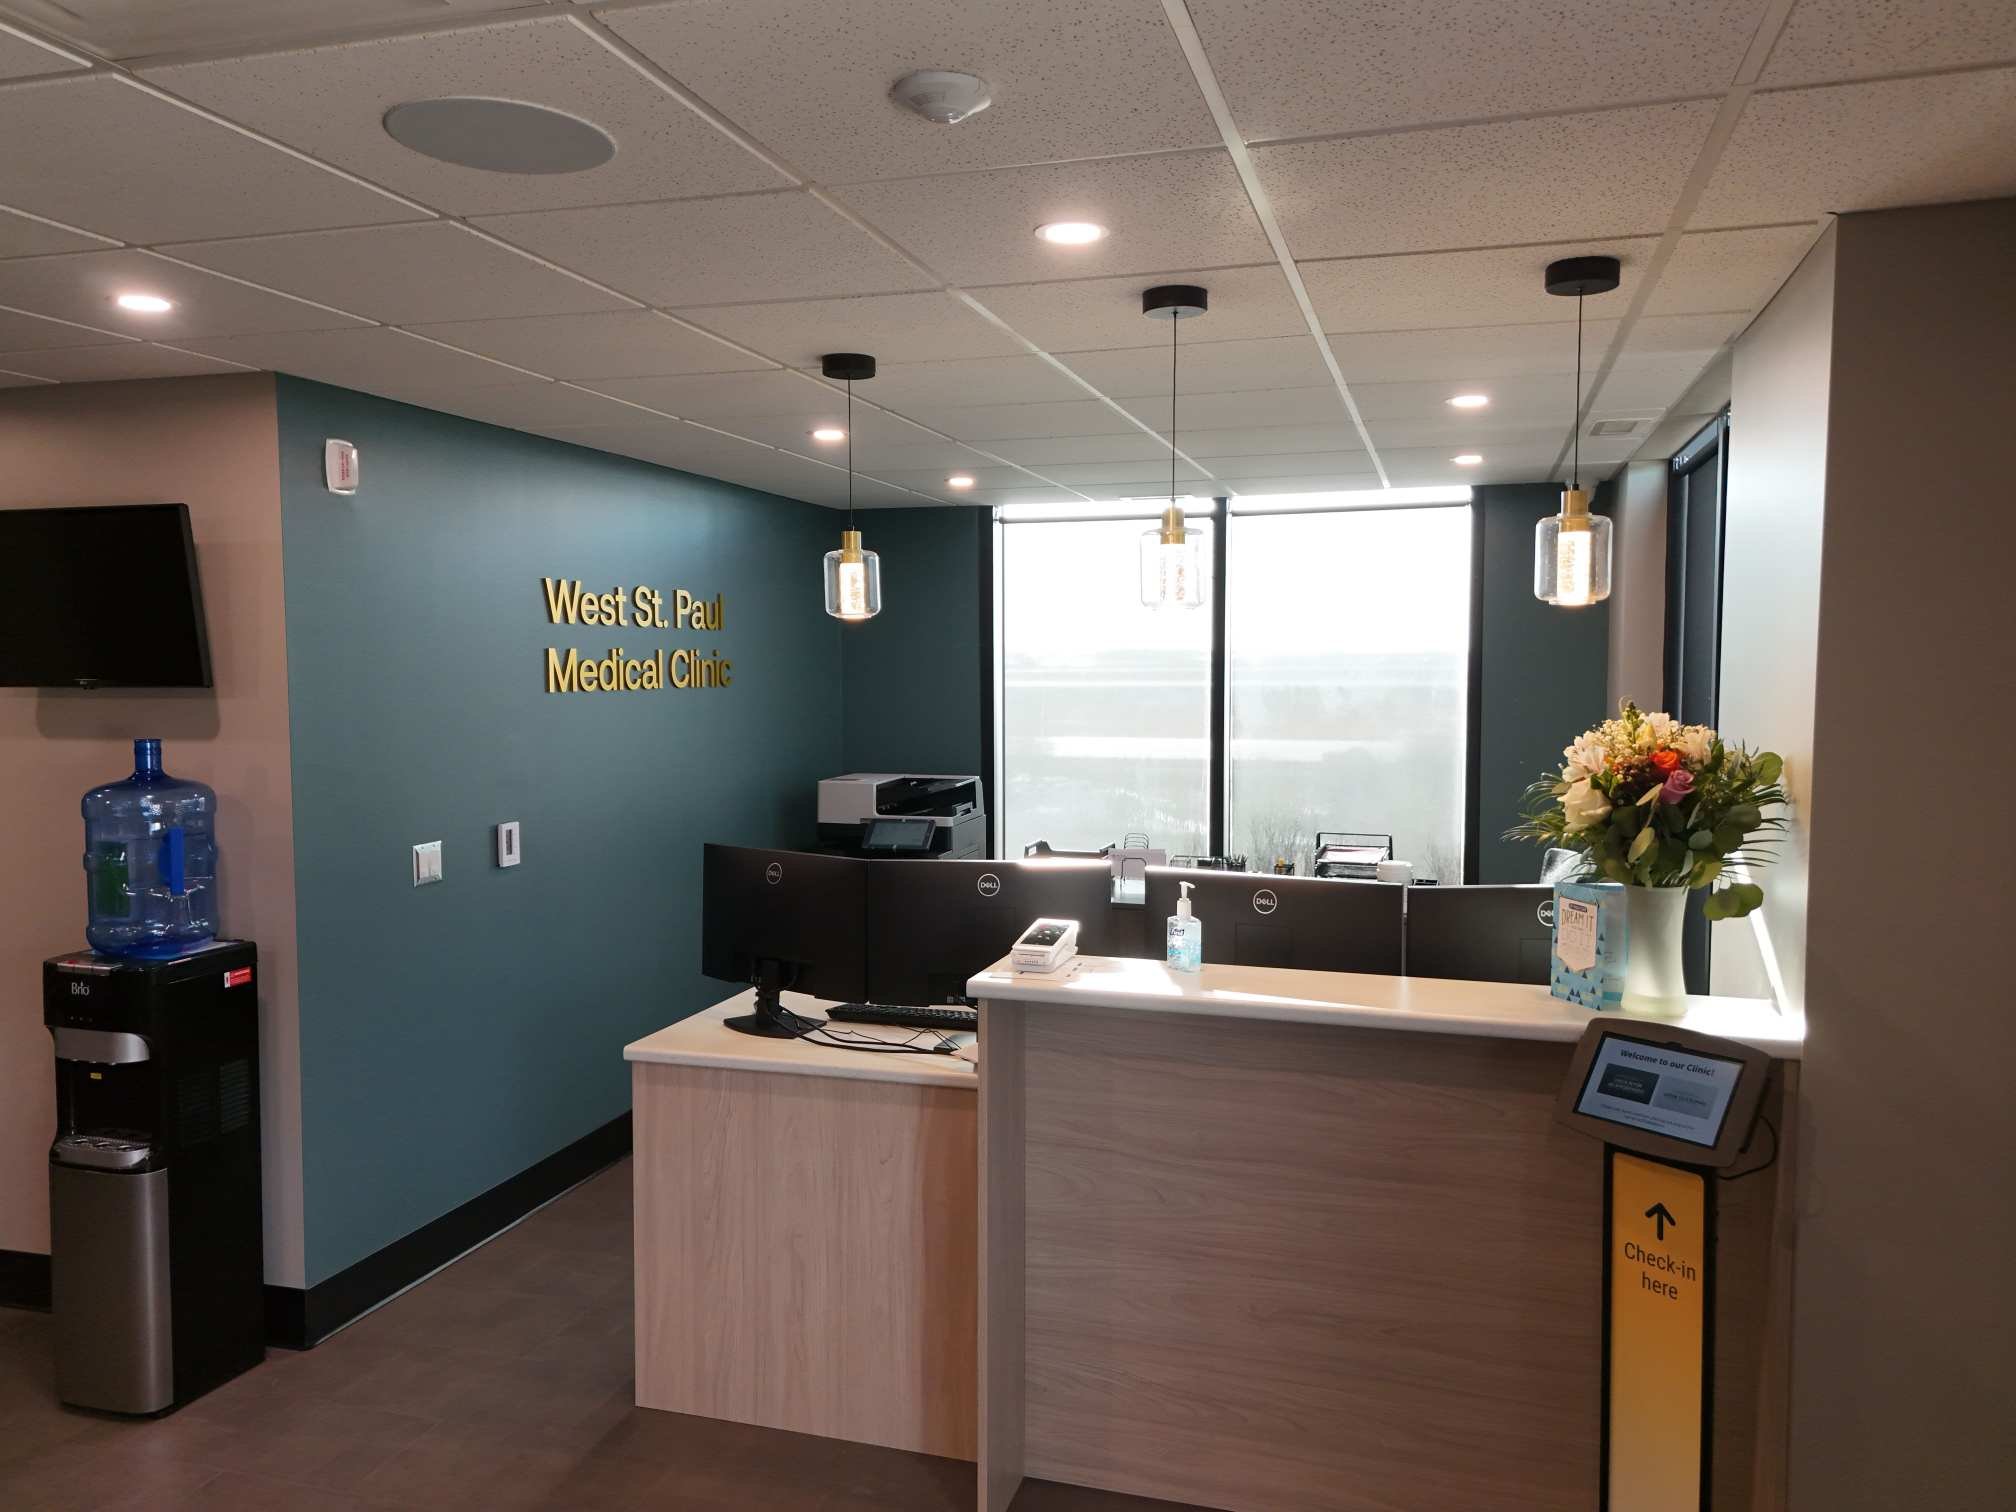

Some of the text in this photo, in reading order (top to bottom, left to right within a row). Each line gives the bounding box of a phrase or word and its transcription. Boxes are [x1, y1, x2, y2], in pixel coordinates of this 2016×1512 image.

[542, 577, 724, 631] West St. Paul
[545, 647, 733, 694] Medical Clinic
[71, 981, 90, 996] Brio
[1620, 1048, 1715, 1077] Welcome to our Clinic!
[1624, 1242, 1696, 1282] Check-in
[1641, 1271, 1678, 1300] here
